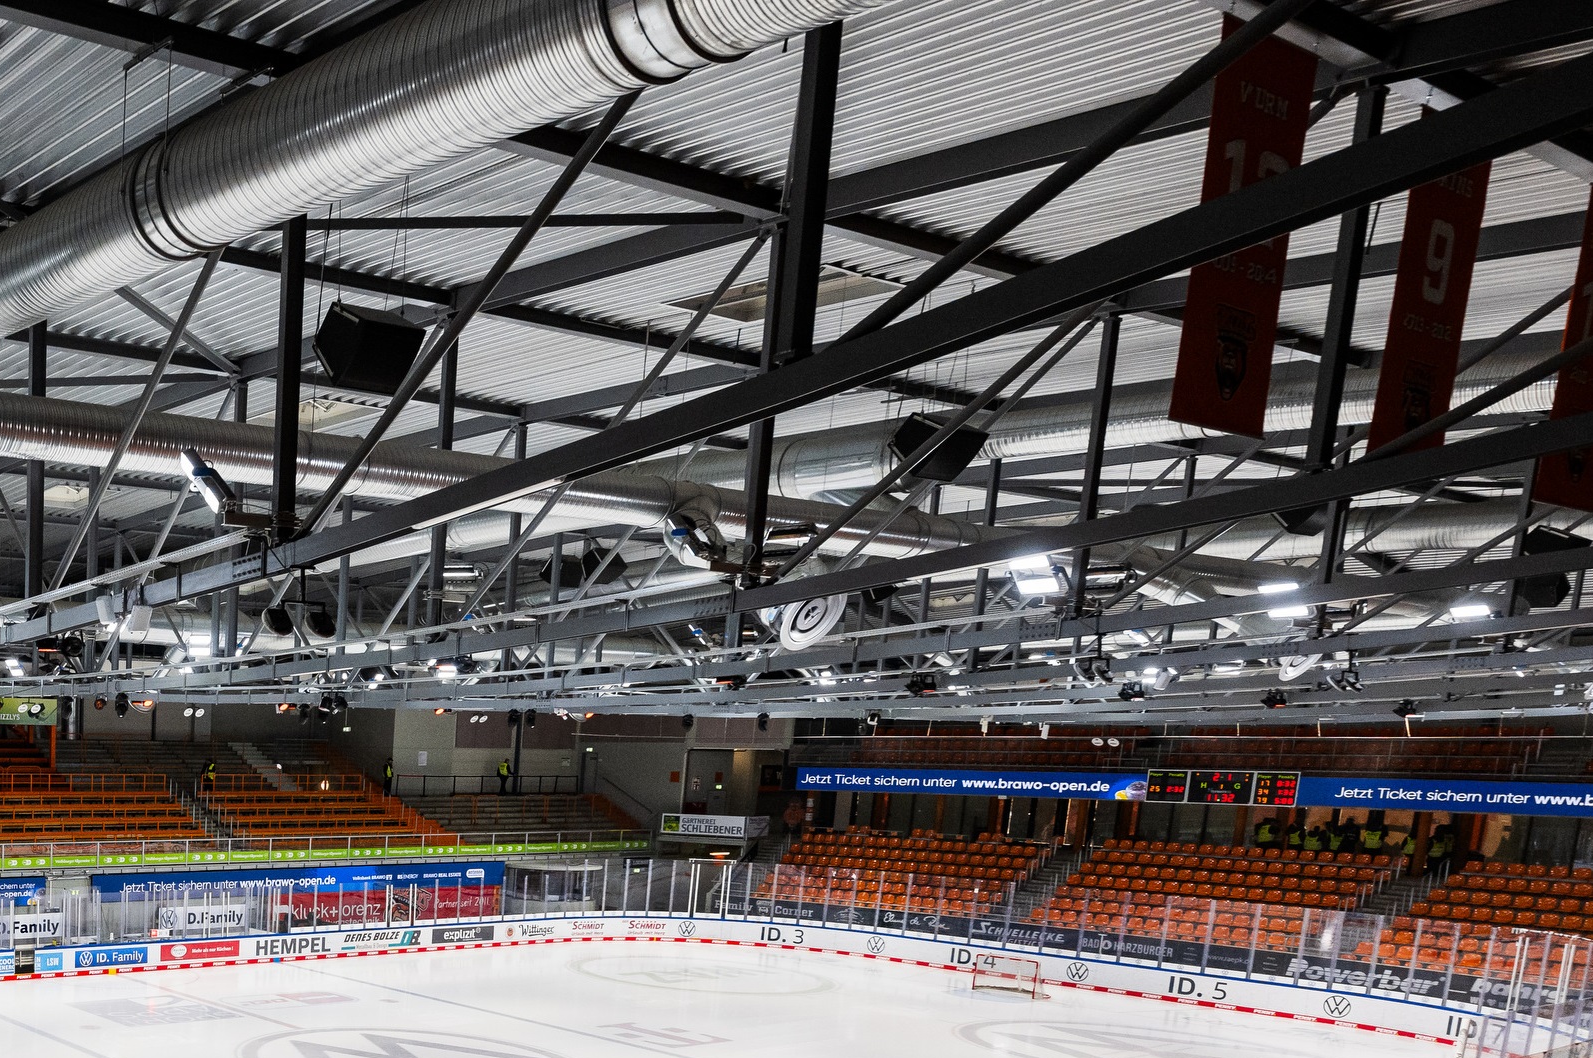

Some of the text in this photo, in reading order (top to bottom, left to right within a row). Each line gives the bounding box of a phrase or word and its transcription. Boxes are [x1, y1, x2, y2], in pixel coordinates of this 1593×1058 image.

[1422, 219, 1456, 305] 9
[801, 774, 1110, 793] Jetzt Ticket sichern unter www.brawo-open.de
[1335, 787, 1373, 798] Jetzt
[1378, 788, 1422, 800] Ticket
[1426, 790, 1482, 802] sichern
[1486, 792, 1530, 804] unter
[681, 824, 742, 835] SCHLIEBENER
[120, 875, 336, 893] Jetzt Ticket sichern unter www.brawo-open.de
[714, 901, 753, 912] Family
[775, 906, 813, 918] Corner
[187, 911, 243, 926] D.Family
[572, 921, 605, 931] SCHMIDT
[628, 920, 666, 930] SCHMIDT
[344, 931, 400, 943] DENES BOLZE
[443, 928, 476, 941] explizit
[518, 924, 555, 937] Wittinger
[761, 927, 804, 944] ID. 3
[256, 937, 331, 955] HEMPEL
[1082, 938, 1099, 948] BAD
[1113, 941, 1173, 957] HARZBURGER
[46, 957, 60, 967] LSW
[96, 951, 144, 964] ID. Family
[950, 948, 996, 969] ID. 4
[1168, 976, 1228, 1000] ID. 5
